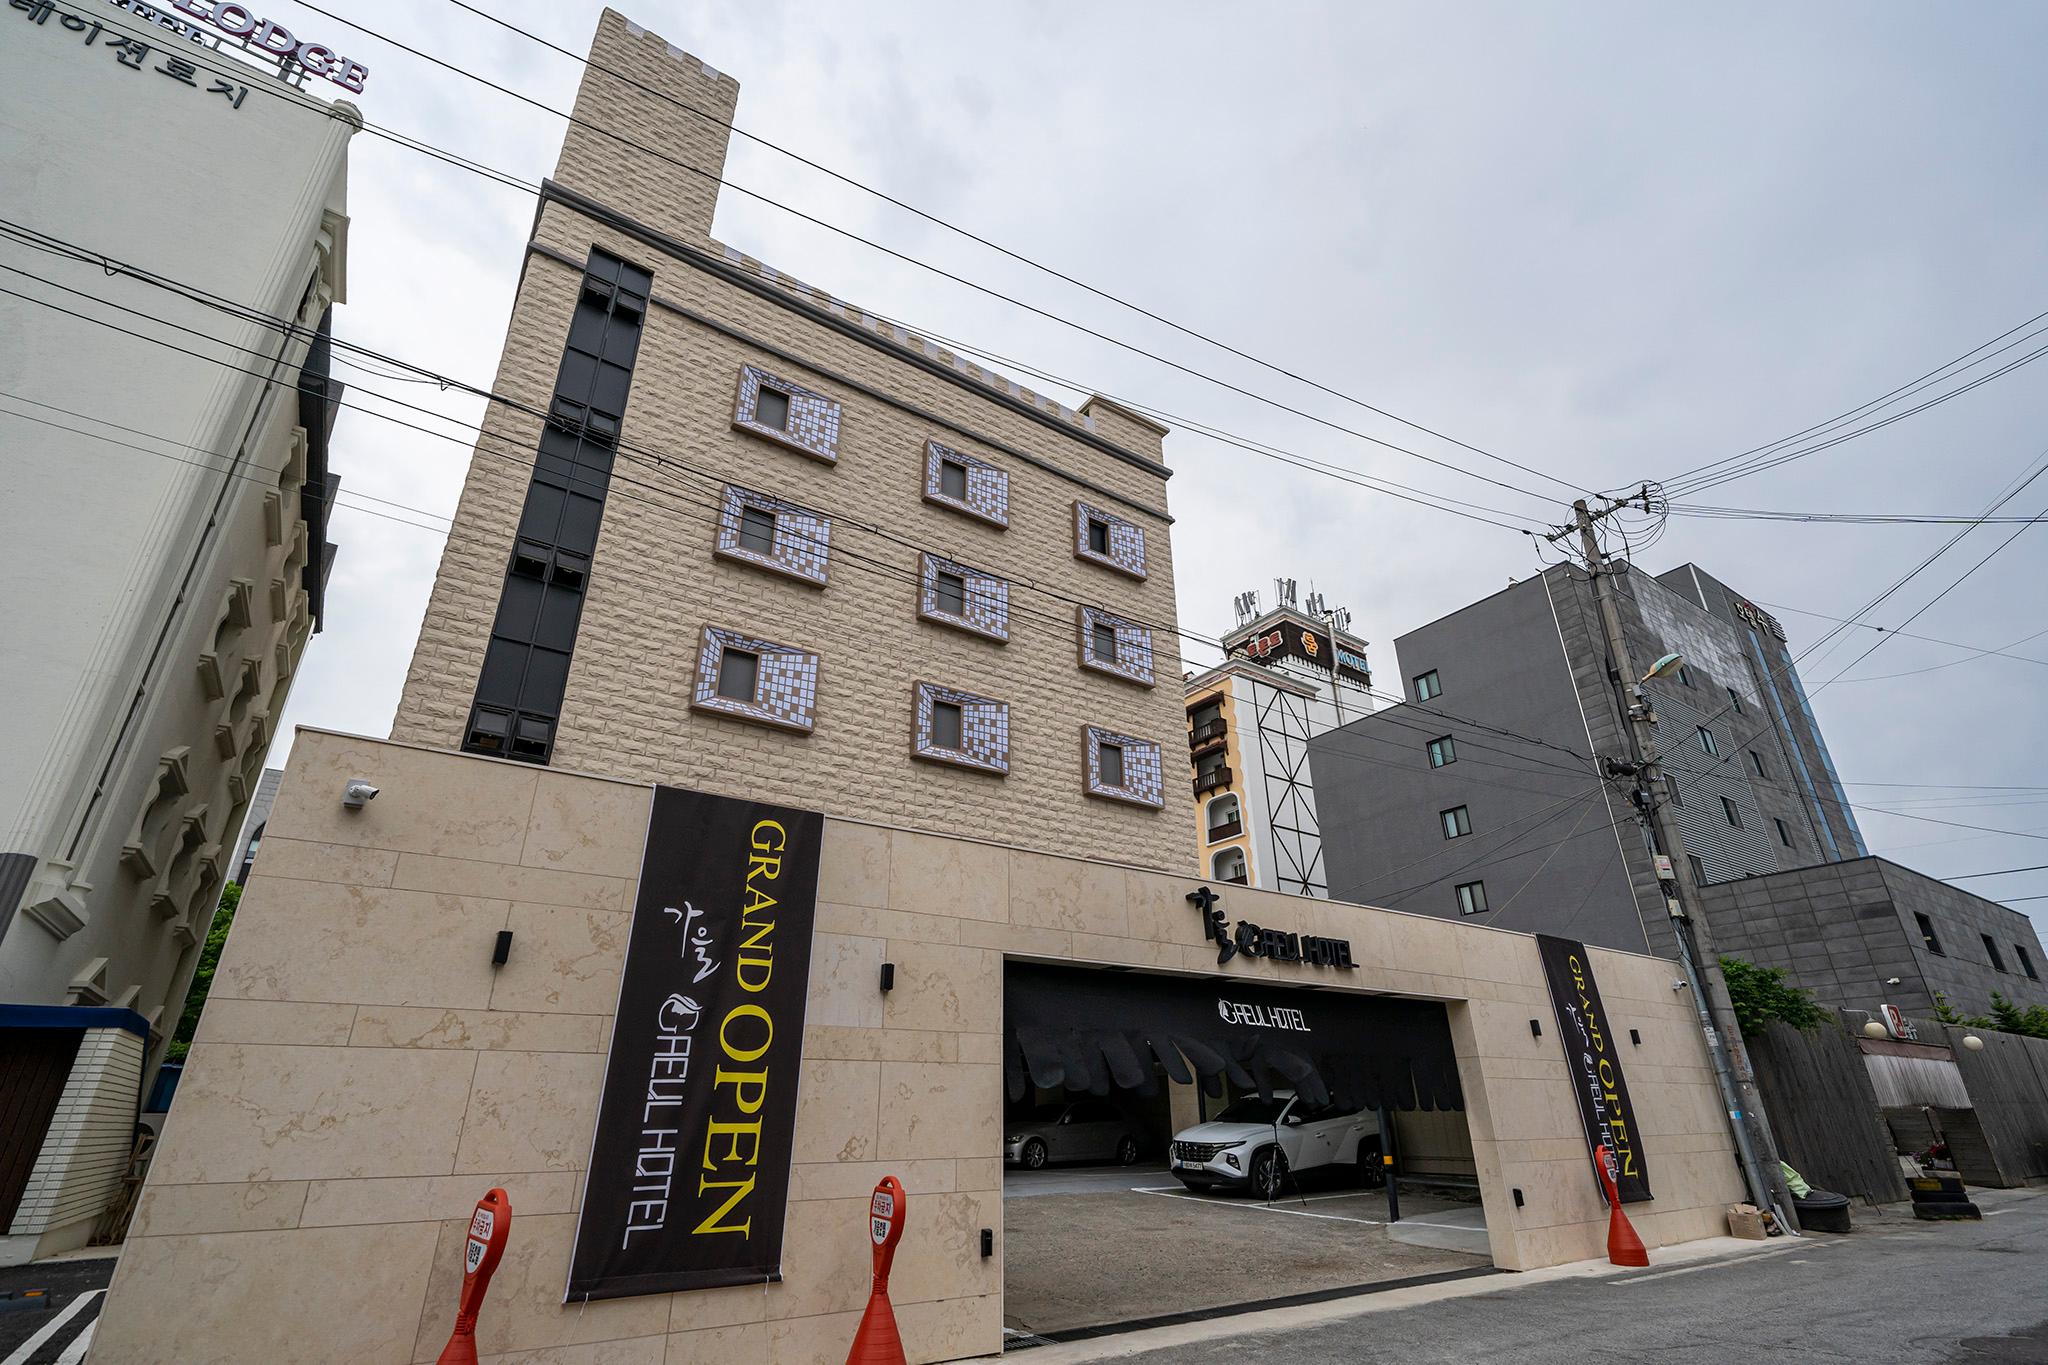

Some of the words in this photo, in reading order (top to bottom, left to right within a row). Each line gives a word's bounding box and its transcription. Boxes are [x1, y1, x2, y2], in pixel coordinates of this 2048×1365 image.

[1337, 649, 1372, 675] MOTEL
[736, 819, 786, 993] GRAND
[1268, 1006, 1311, 1032] HOTEL
[1568, 955, 1604, 1053] GRAND
[1599, 1058, 1639, 1179] OPEN
[622, 1128, 679, 1250] HOTEL
[692, 1004, 773, 1241] OPEN
